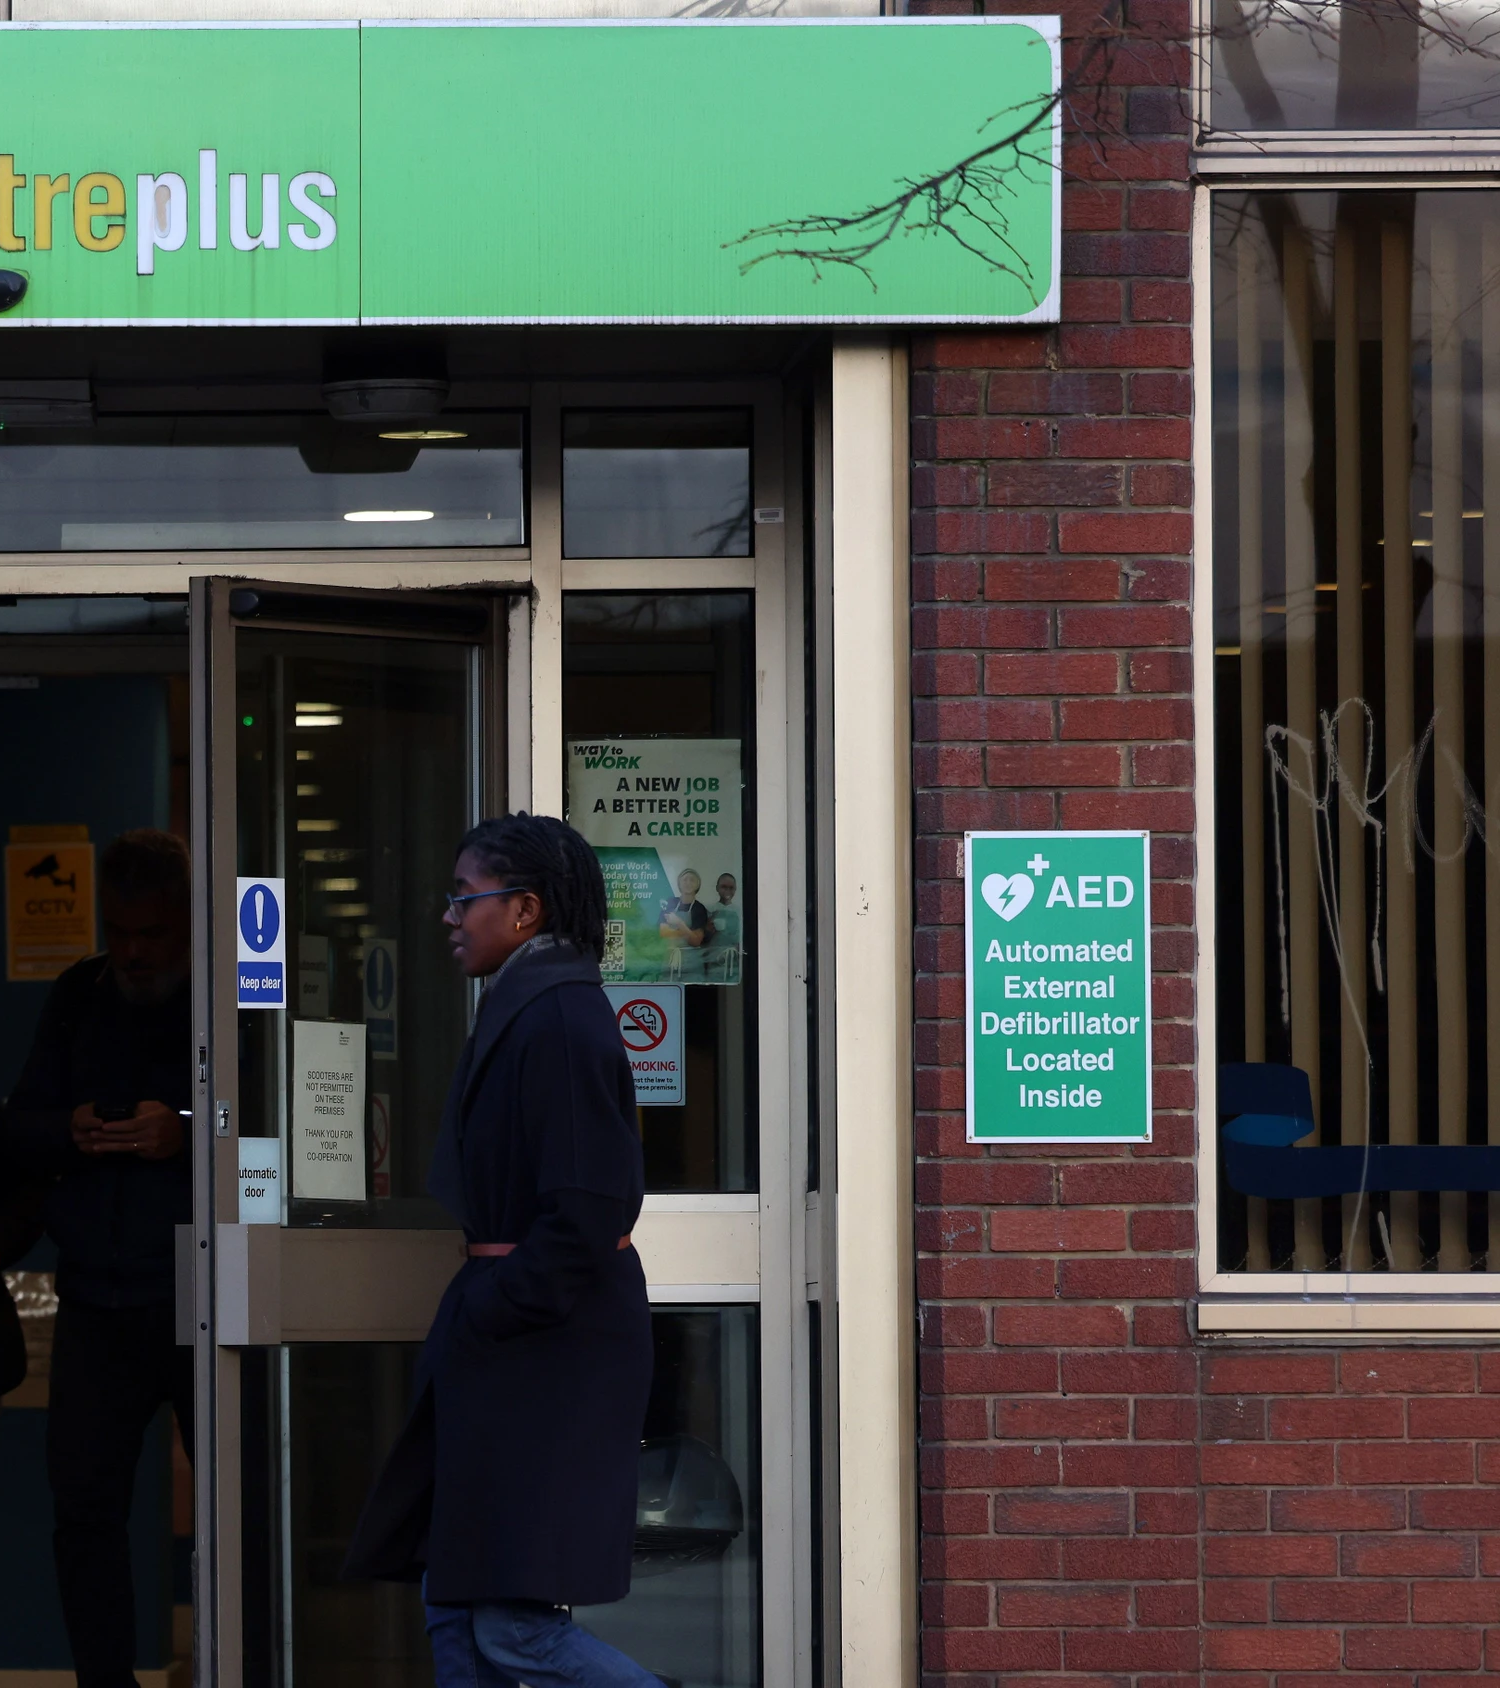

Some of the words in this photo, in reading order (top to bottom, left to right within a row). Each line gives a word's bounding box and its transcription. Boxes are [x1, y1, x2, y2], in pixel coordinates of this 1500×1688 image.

[573, 745, 610, 762] way
[610, 746, 623, 755] to
[584, 756, 641, 769] WORK
[616, 778, 629, 791] A
[635, 778, 681, 791] NEW
[684, 777, 719, 795] JOB
[593, 799, 607, 813] A
[612, 799, 680, 813] BETTER
[684, 799, 719, 817] JOB
[627, 822, 641, 836] A
[646, 822, 718, 836] CAREER
[605, 863, 625, 872] your
[627, 862, 650, 870] Work
[602, 871, 627, 881] today
[629, 872, 638, 880] to
[640, 871, 658, 880] find
[611, 881, 631, 891] they
[1045, 875, 1134, 908] AED
[613, 890, 630, 898] find
[632, 891, 652, 900] your
[25, 899, 76, 915] CCTV
[985, 939, 1133, 962] Automated
[240, 974, 260, 991] Keep
[261, 974, 281, 990] clear
[1004, 975, 1115, 998] External
[980, 1011, 1140, 1035] Defibrillator
[1006, 1047, 1115, 1071] Located
[307, 1071, 340, 1081] SCOOTERS
[340, 1073, 354, 1081] ARE
[306, 1083, 319, 1091] NOT
[319, 1083, 354, 1093] PERMITTED
[315, 1094, 324, 1103] ON
[325, 1095, 344, 1104] THESE
[1019, 1084, 1102, 1107] Inside
[314, 1106, 345, 1115] PREMISES
[305, 1128, 326, 1138] THANK
[326, 1129, 339, 1139] YOU
[340, 1130, 354, 1139] FOR
[320, 1141, 338, 1150] YOUR
[306, 1151, 353, 1162] CO-OPERATION
[238, 1167, 277, 1179] utomatic
[244, 1185, 265, 1198] door
